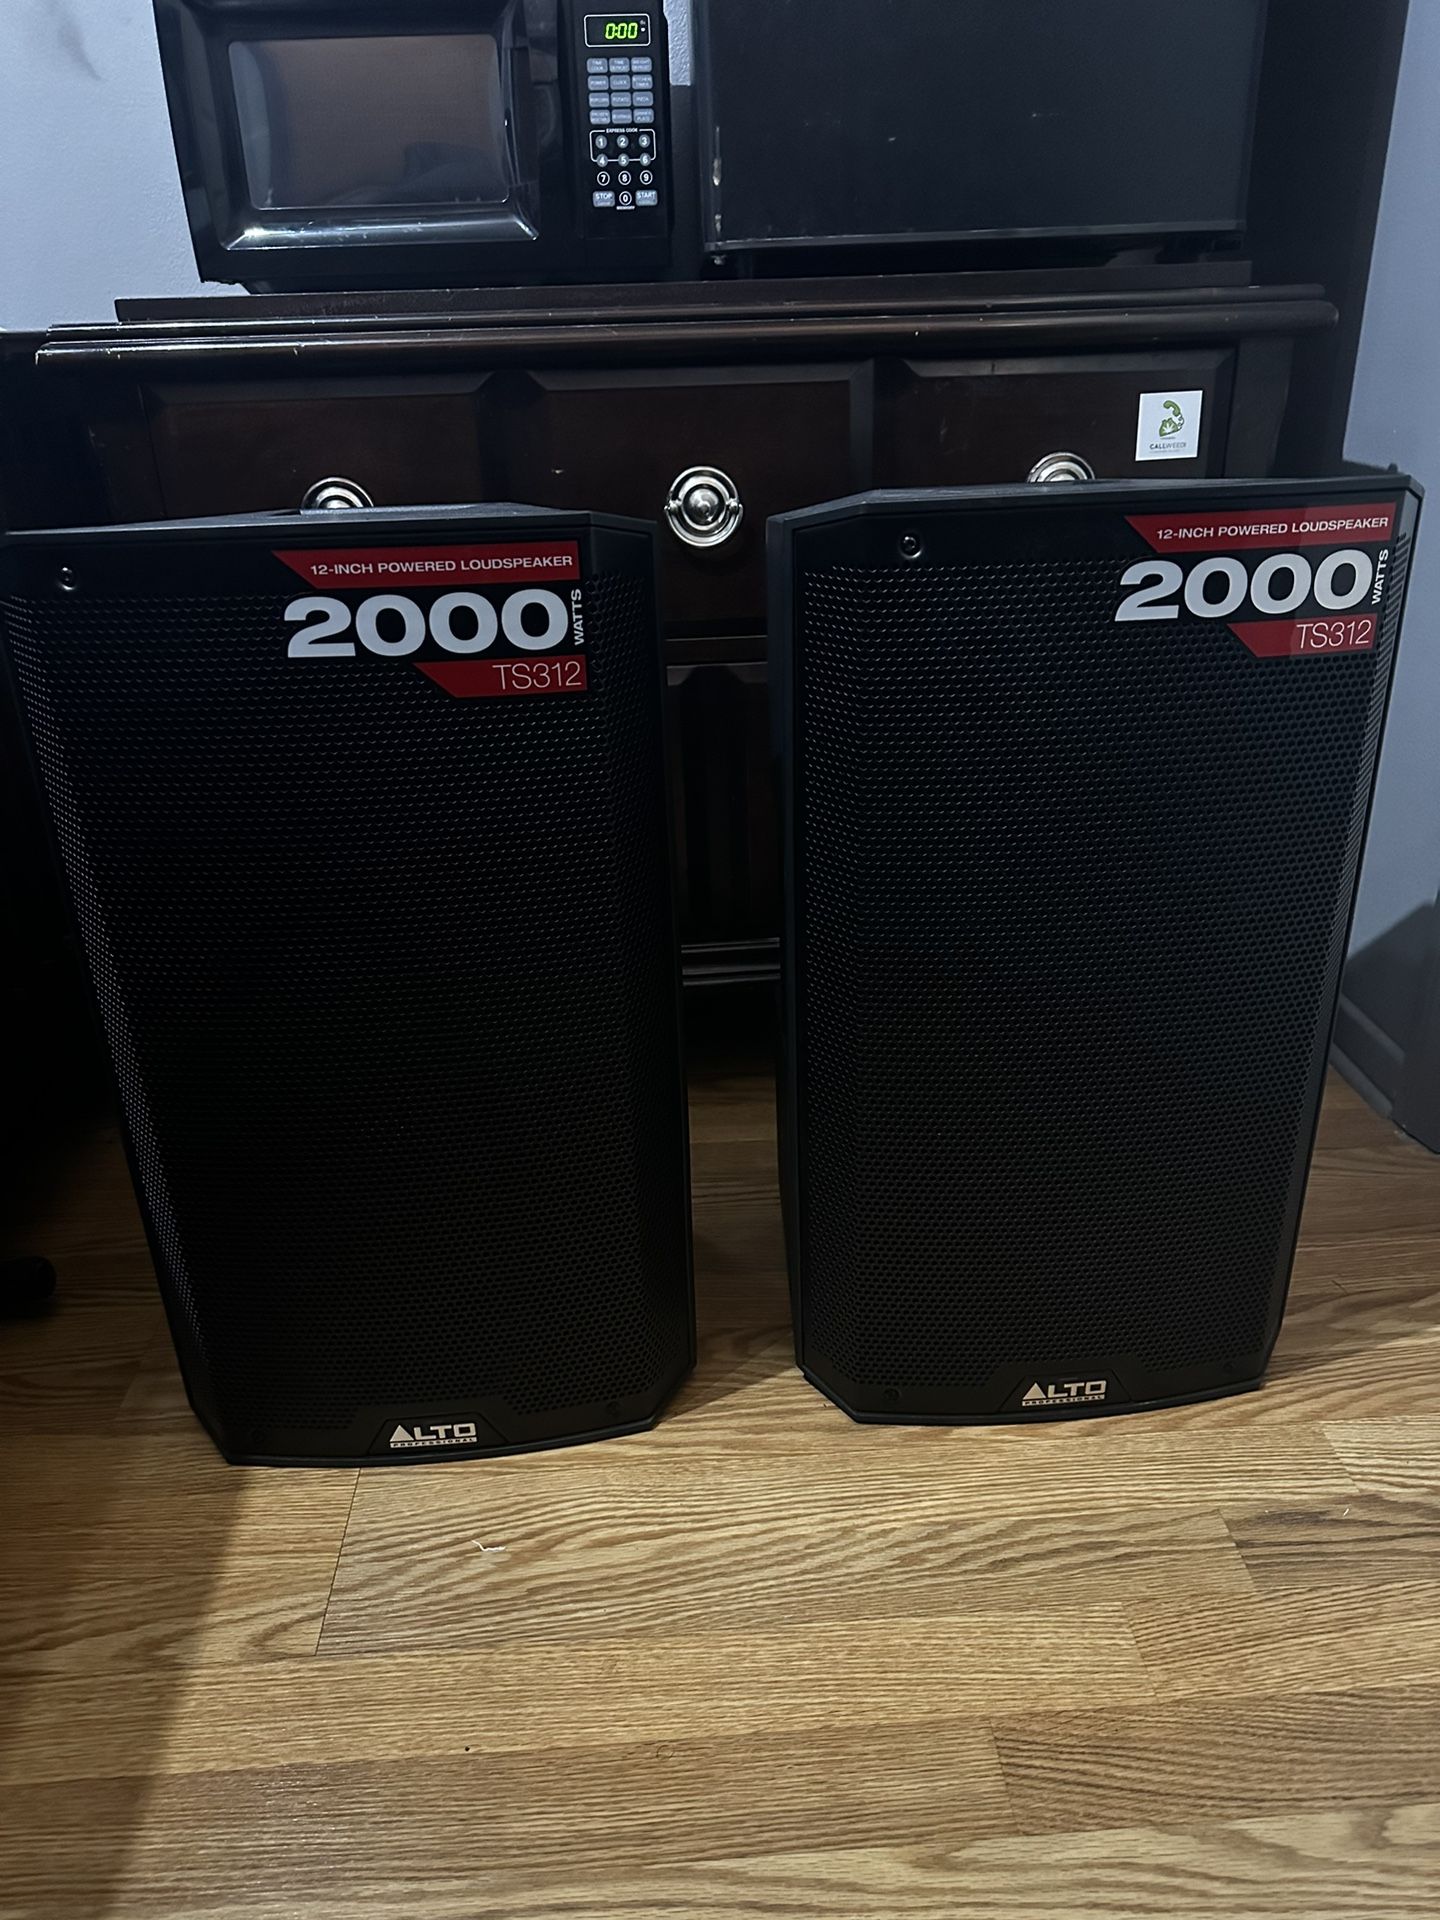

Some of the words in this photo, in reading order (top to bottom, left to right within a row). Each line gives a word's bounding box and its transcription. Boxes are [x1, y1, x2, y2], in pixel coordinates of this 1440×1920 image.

[605, 22, 638, 39] 0:00
[620, 137, 626, 146] 2
[641, 136, 648, 146] 3
[599, 156, 606, 165] 4
[621, 155, 627, 165] 5
[642, 154, 648, 164] 6
[622, 173, 628, 183] 8
[643, 173, 649, 182] 9
[595, 192, 613, 200] STOP
[622, 194, 628, 203] 0
[636, 191, 656, 199] START
[1157, 526, 1214, 540] 12-INCH
[1218, 523, 1288, 537] POWERED
[1292, 517, 1389, 533] LOUDSPEAKER
[310, 563, 374, 576] 12-INCH
[378, 560, 456, 574] POWERED
[460, 555, 573, 571] LOUDSPEAKER
[1114, 549, 1374, 622] 2000
[1371, 549, 1389, 605] WATTS
[284, 588, 569, 658] 2000
[571, 588, 585, 646] WATTS
[1296, 619, 1372, 649] TS312
[492, 661, 582, 690] TS312
[1022, 1380, 1106, 1400] ALTO
[390, 1423, 476, 1442] ALTO
[390, 1437, 477, 1448] PROFESSIONAL
